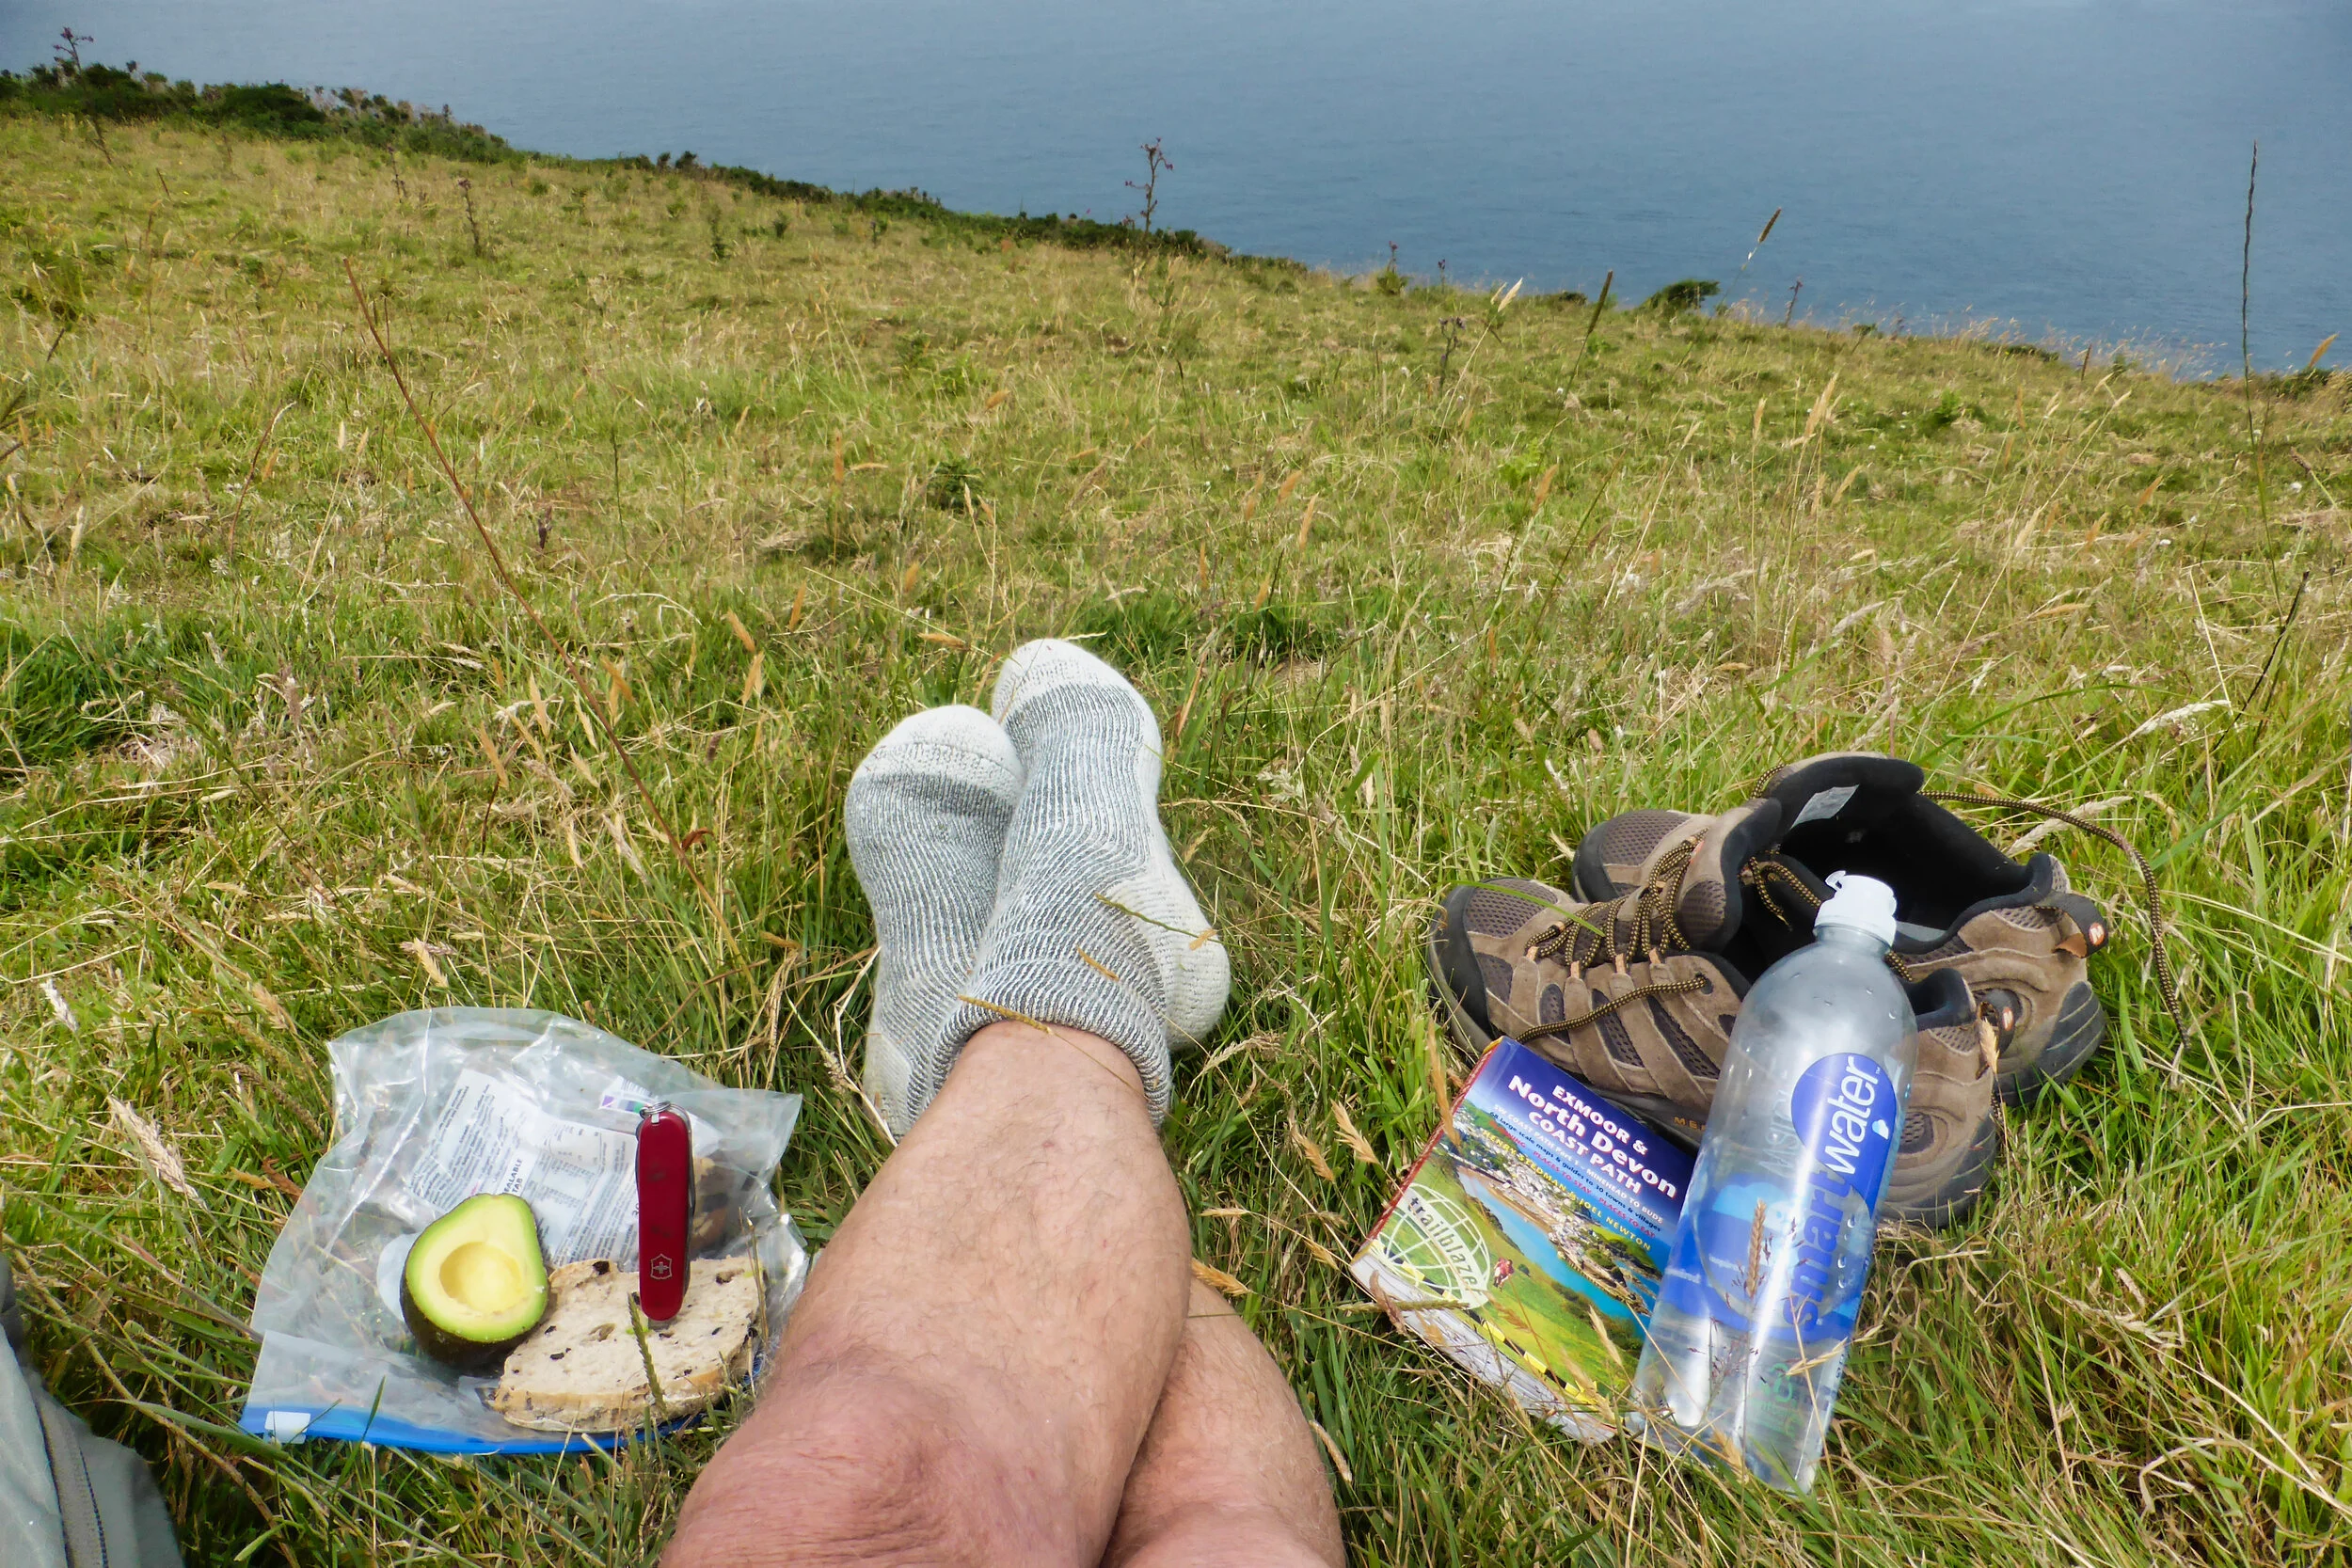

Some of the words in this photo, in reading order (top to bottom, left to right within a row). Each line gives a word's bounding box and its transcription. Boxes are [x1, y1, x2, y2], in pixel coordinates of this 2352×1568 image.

[1508, 1075, 1586, 1137] North
[1591, 1132, 1677, 1199] Devon
[1528, 1112, 1589, 1156] COAST
[1590, 1152, 1642, 1195] PATH
[1552, 1085, 1630, 1145] EXMOOR
[1632, 1140, 1648, 1156] &
[1481, 1129, 1518, 1156] HENRY
[1518, 1152, 1566, 1193] STEDMAN
[1579, 1198, 1603, 1219] JOEL
[1606, 1216, 1652, 1251] NEWTON
[1506, 1113, 1534, 1134] COAST
[1534, 1130, 1553, 1149] PATH
[1554, 1145, 1574, 1162] Part
[1586, 1167, 1628, 1199] MINEHEAD
[1629, 1196, 1640, 1208] TO
[1642, 1205, 1664, 1224] BUDE
[1533, 1150, 1561, 1173] PLACES
[1561, 1168, 1572, 1182] TO
[1573, 1178, 1593, 1196] STAY
[1599, 1196, 1628, 1219] PLACES
[1629, 1214, 1639, 1228] TO
[1640, 1224, 1656, 1238] EAT
[1536, 1142, 1554, 1158] maps
[1562, 1159, 1584, 1180] guides
[1585, 1177, 1594, 1187] to
[1596, 1182, 1604, 1194] 30
[1605, 1189, 1627, 1209] towns
[1634, 1210, 1661, 1233] villages
